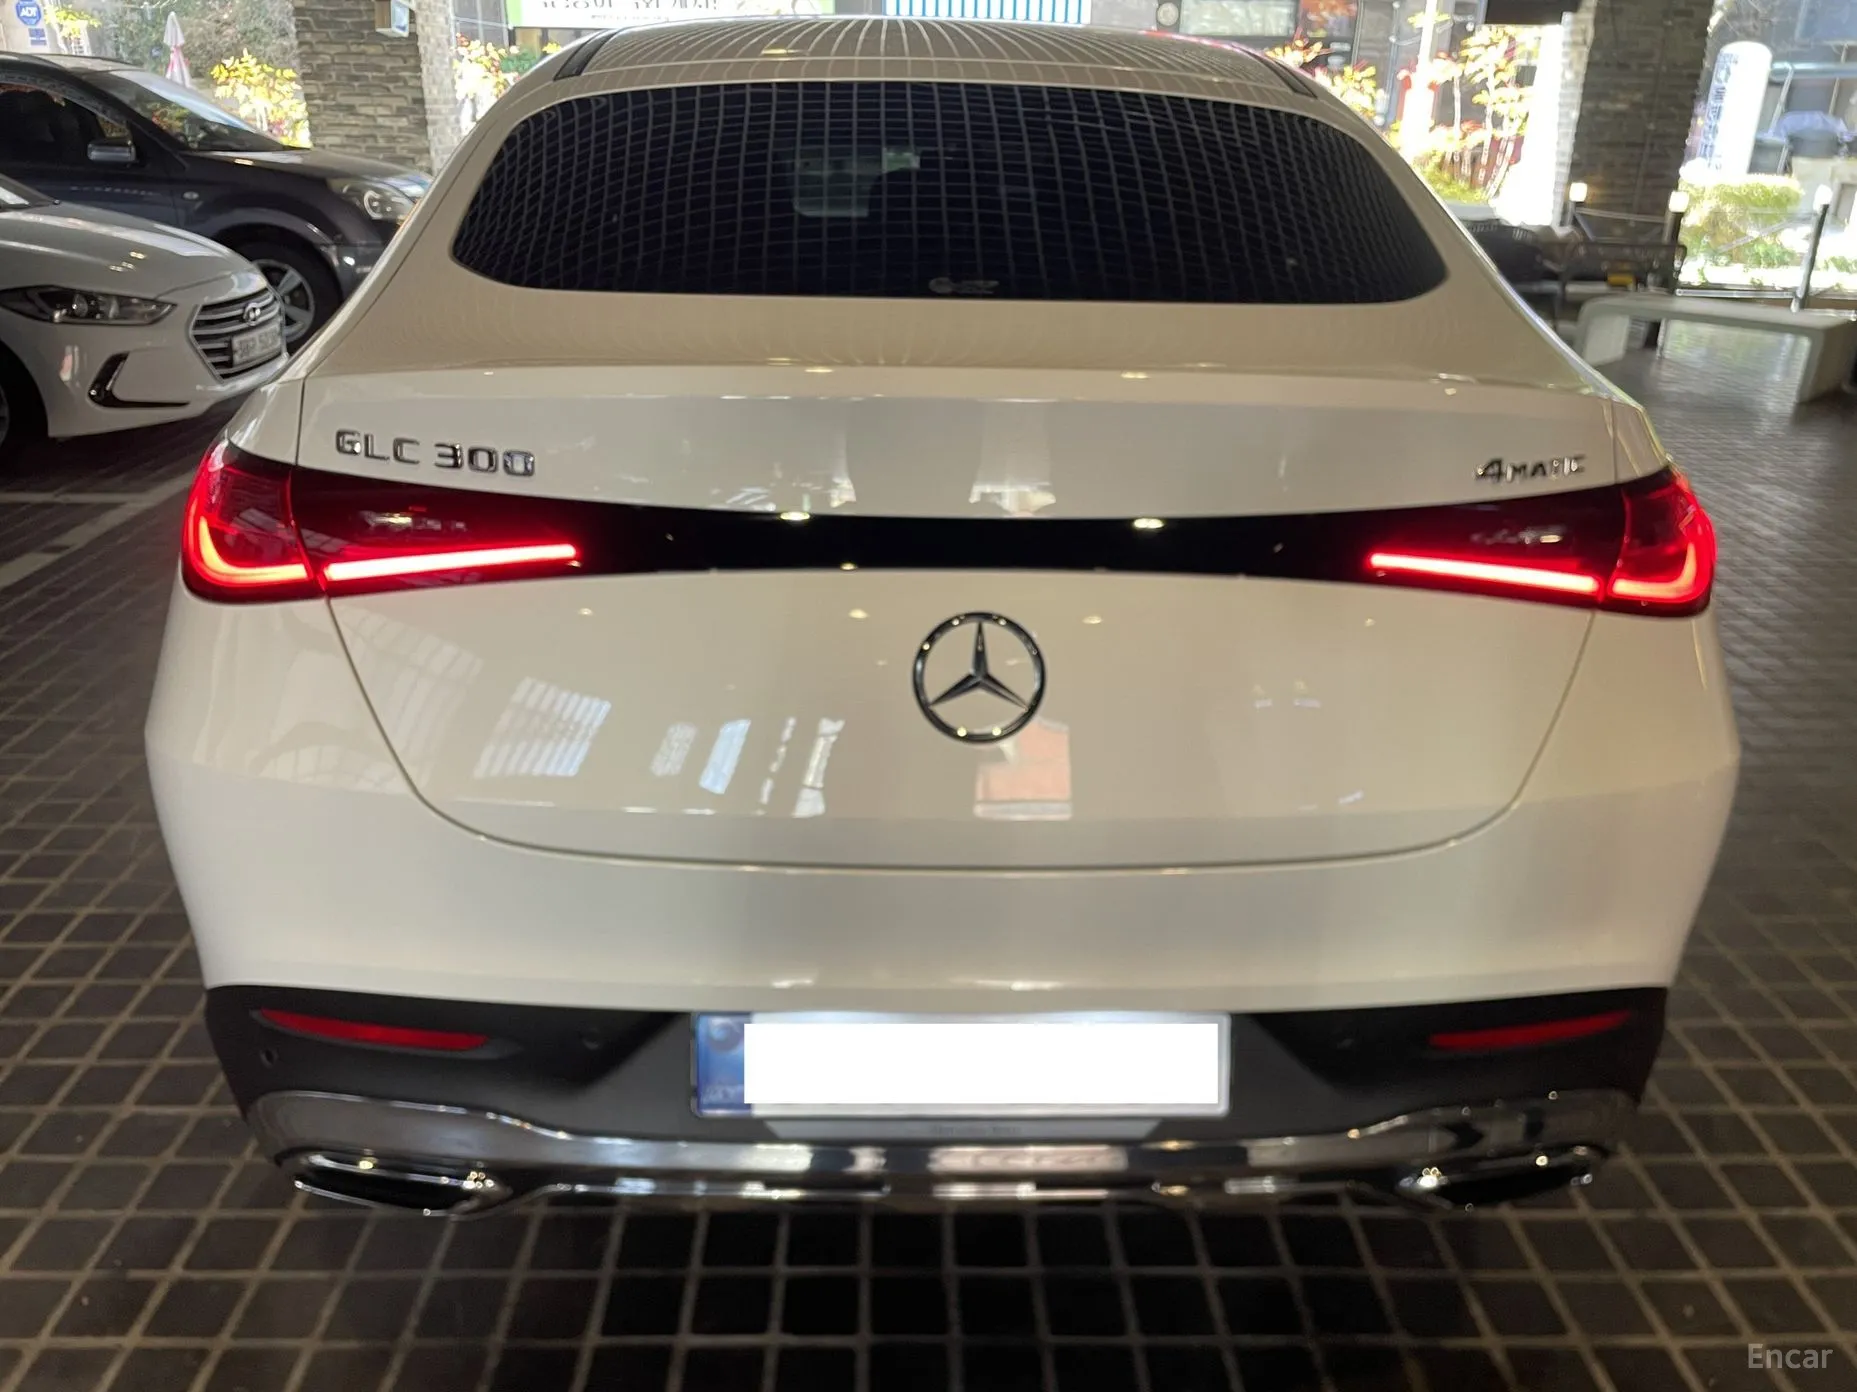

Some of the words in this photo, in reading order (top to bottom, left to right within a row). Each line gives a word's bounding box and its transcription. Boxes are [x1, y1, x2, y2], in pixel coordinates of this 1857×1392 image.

[20, 6, 38, 17] ADT
[336, 429, 420, 464] GLC
[434, 443, 535, 477] 300
